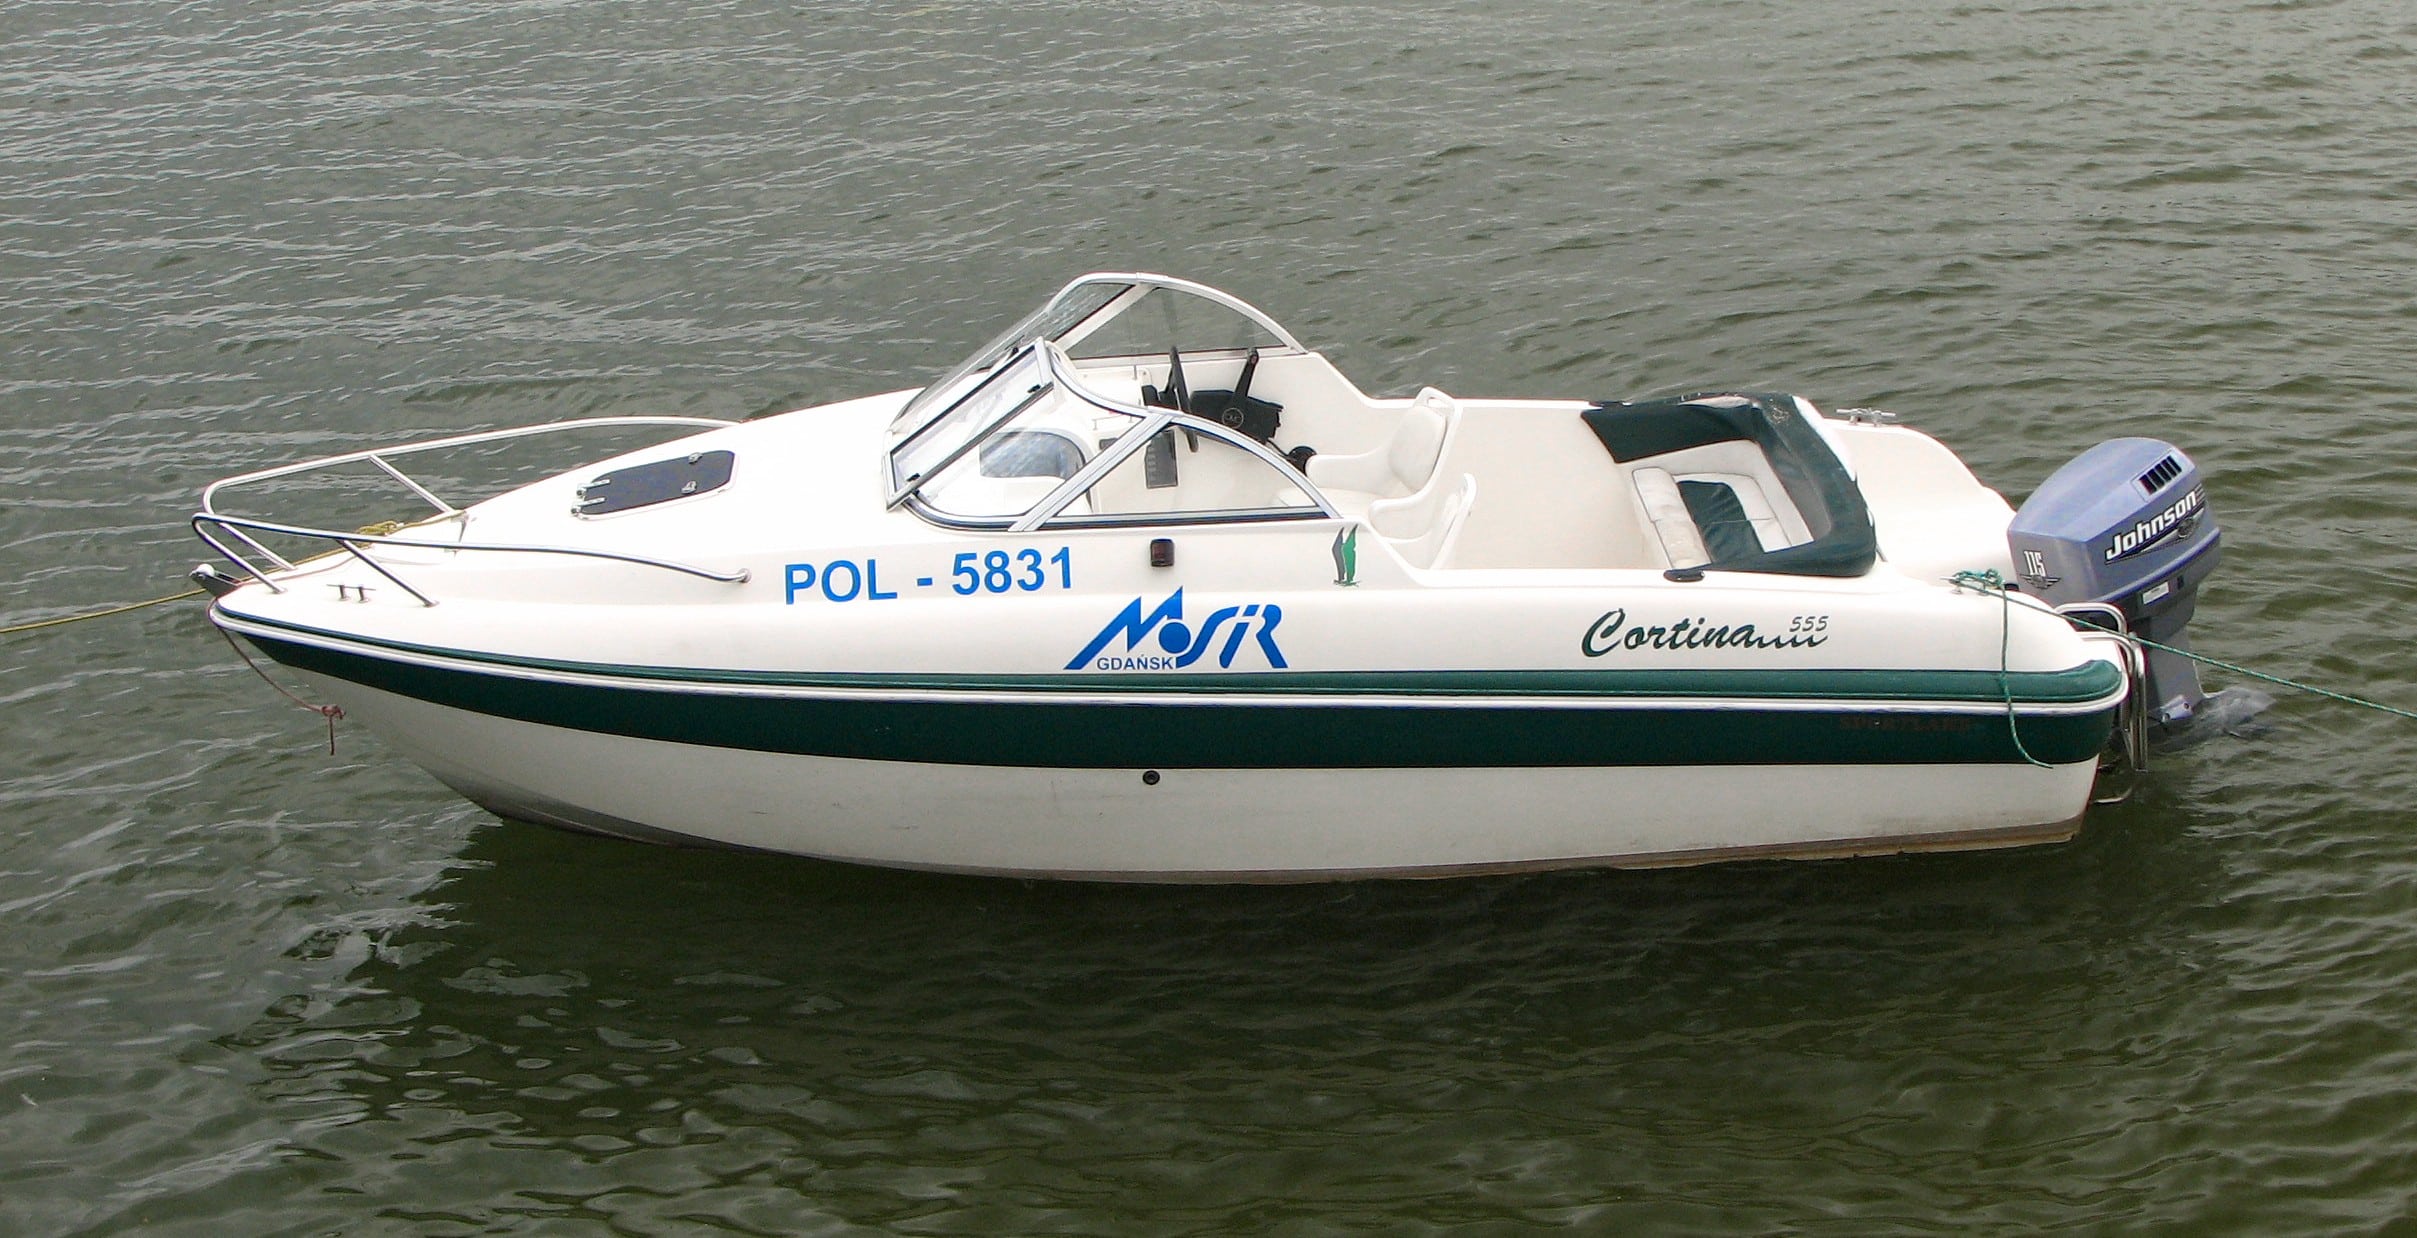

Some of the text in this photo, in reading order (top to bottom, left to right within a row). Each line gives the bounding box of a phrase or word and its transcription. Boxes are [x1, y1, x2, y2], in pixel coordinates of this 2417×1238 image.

[2104, 490, 2198, 562] Johnson
[784, 546, 1073, 605] POL - 5831
[2023, 550, 2047, 577] 115
[1581, 607, 1829, 658] Cortina 555
[1096, 653, 1174, 671] GDAŃSK
